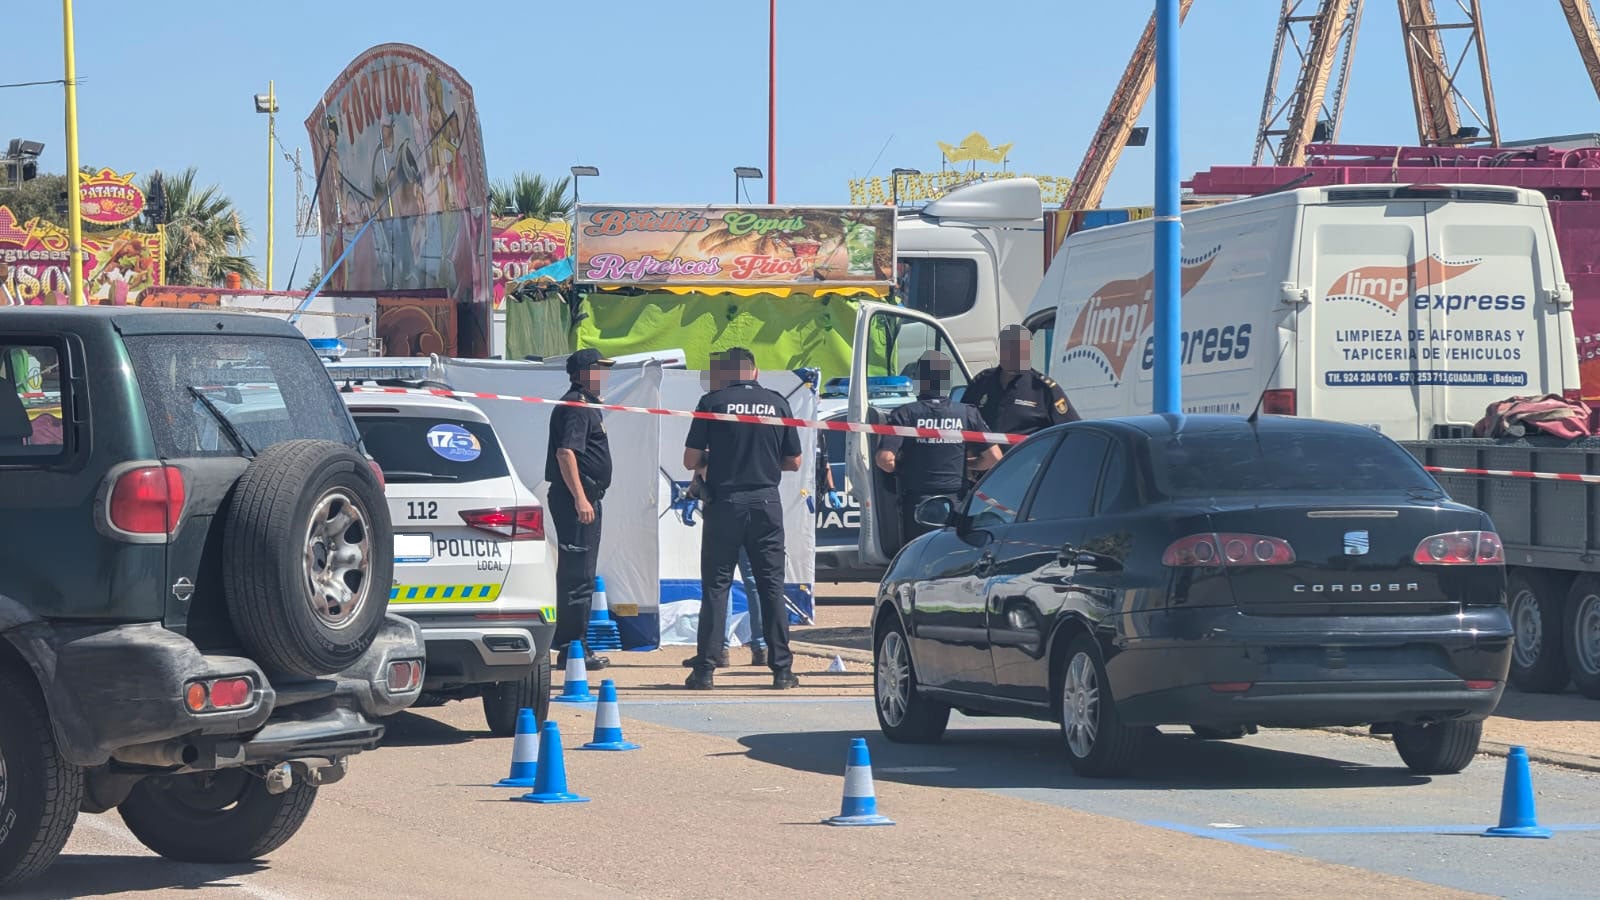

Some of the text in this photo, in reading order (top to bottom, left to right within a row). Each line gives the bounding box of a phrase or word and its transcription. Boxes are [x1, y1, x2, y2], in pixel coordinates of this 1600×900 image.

[342, 70, 382, 145] TORO
[80, 186, 136, 201] PATATAS
[723, 212, 806, 235] Copas
[492, 238, 557, 254] Kebab
[586, 254, 806, 280] Refrescos Frios
[1414, 293, 1525, 314] express
[1082, 290, 1151, 357] limpi
[1336, 330, 1525, 342] LIMPIEZA DE ALFOMBRAS Y
[1141, 323, 1251, 371] eress
[1342, 348, 1521, 360] TAPICERIA DE VEHICULOS
[1343, 373, 1359, 383] 924
[1361, 373, 1376, 383] 204
[1378, 373, 1392, 383] 010
[1417, 373, 1432, 382] 253
[727, 403, 776, 415] POLICIA
[917, 418, 963, 430] POLICIA
[407, 501, 438, 519] 112
[437, 538, 502, 557] POLICIA
[477, 560, 504, 571] LOCAL
[1293, 583, 1419, 592] CORDOBA
